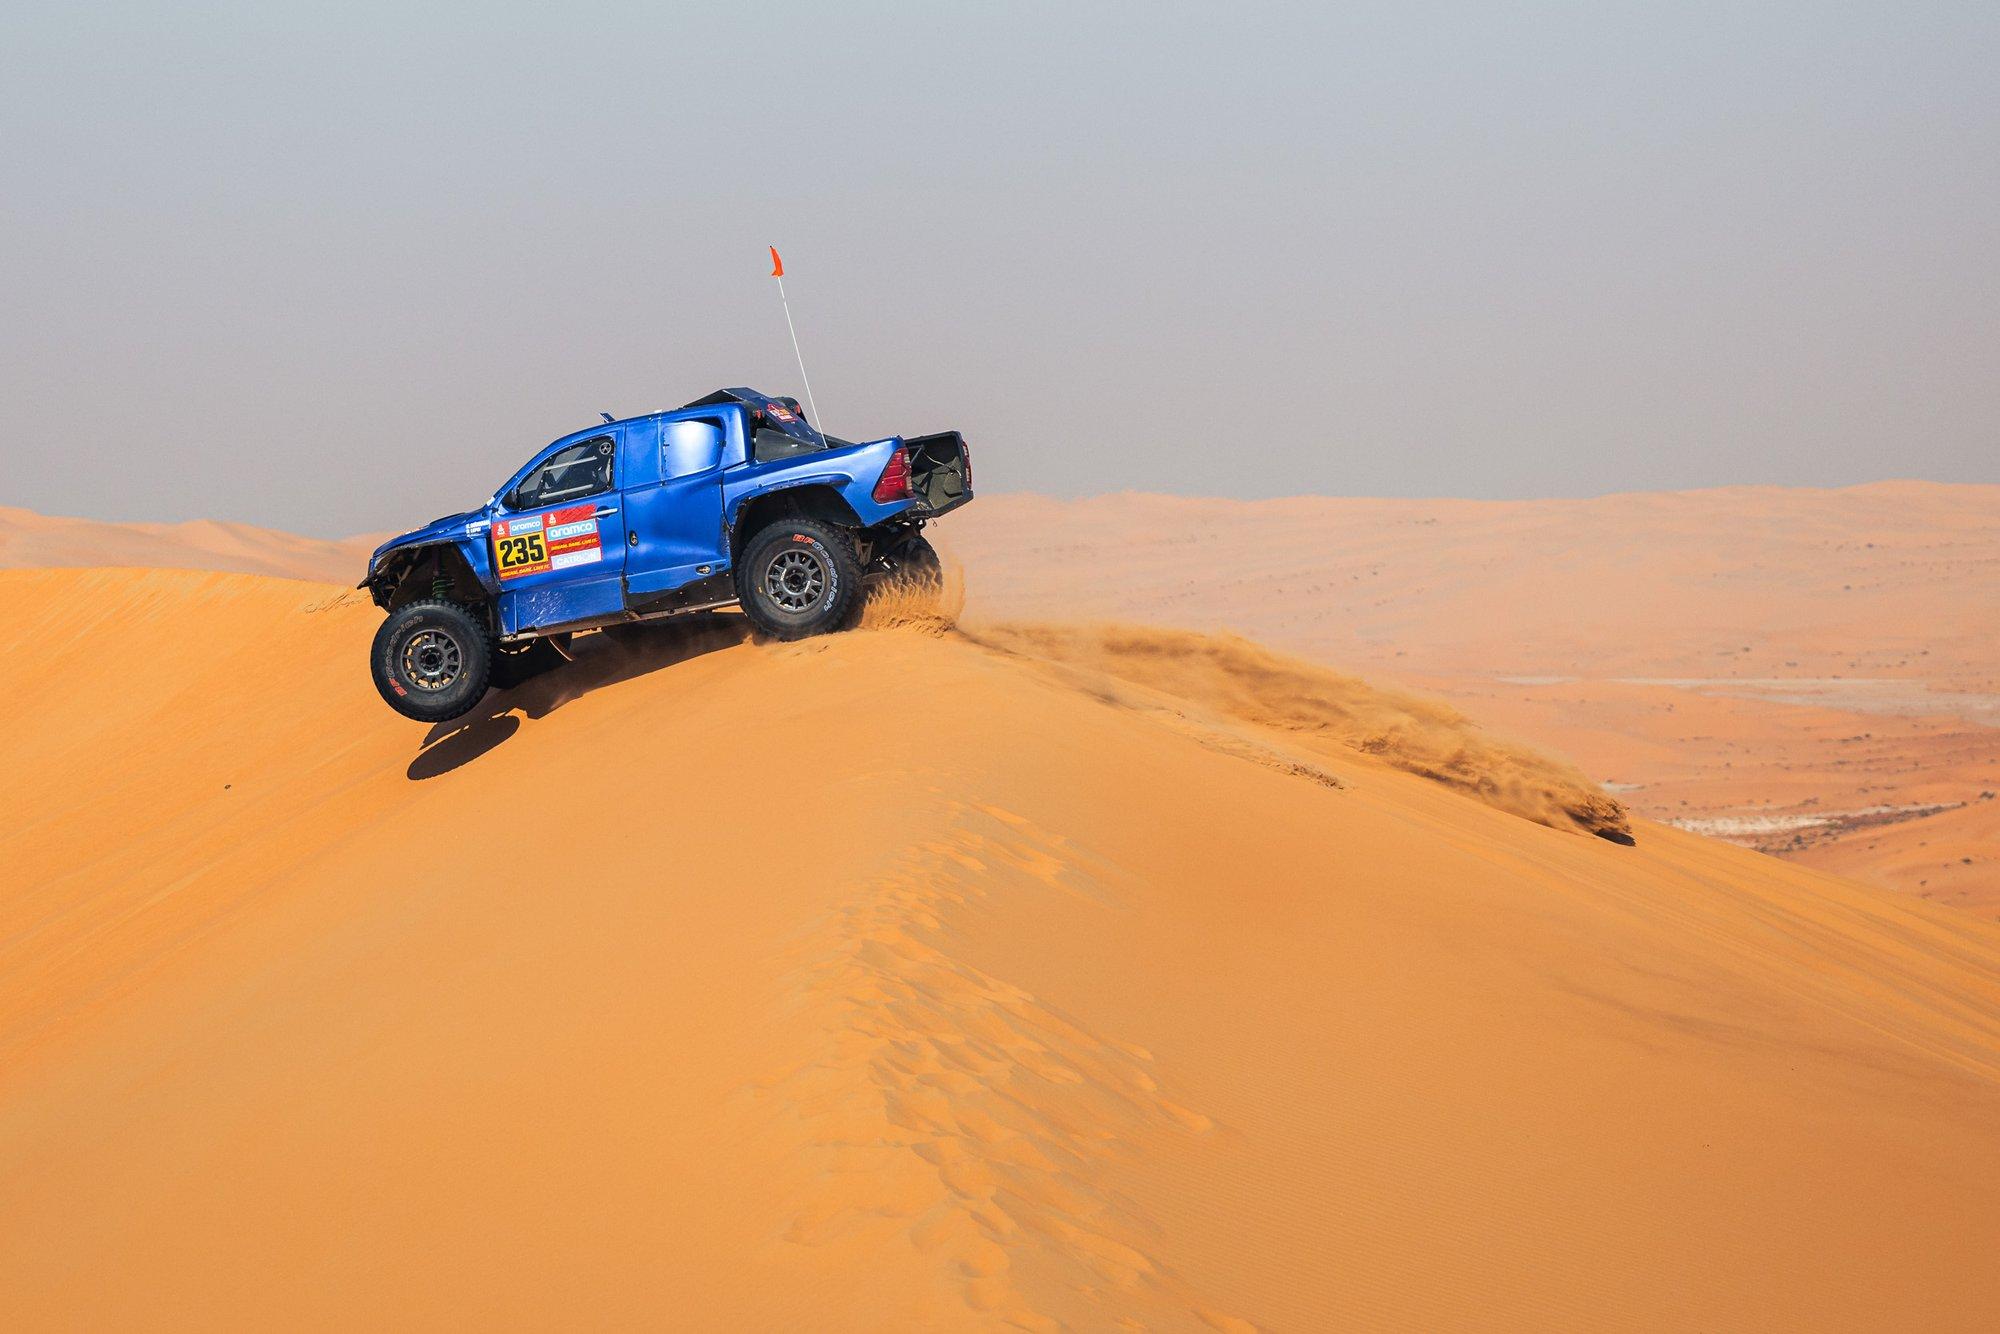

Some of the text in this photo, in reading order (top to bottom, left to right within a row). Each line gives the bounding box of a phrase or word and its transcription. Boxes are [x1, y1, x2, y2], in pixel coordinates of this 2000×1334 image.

[511, 520, 541, 532] aramco
[550, 522, 593, 538] aramco
[499, 534, 545, 568] 235
